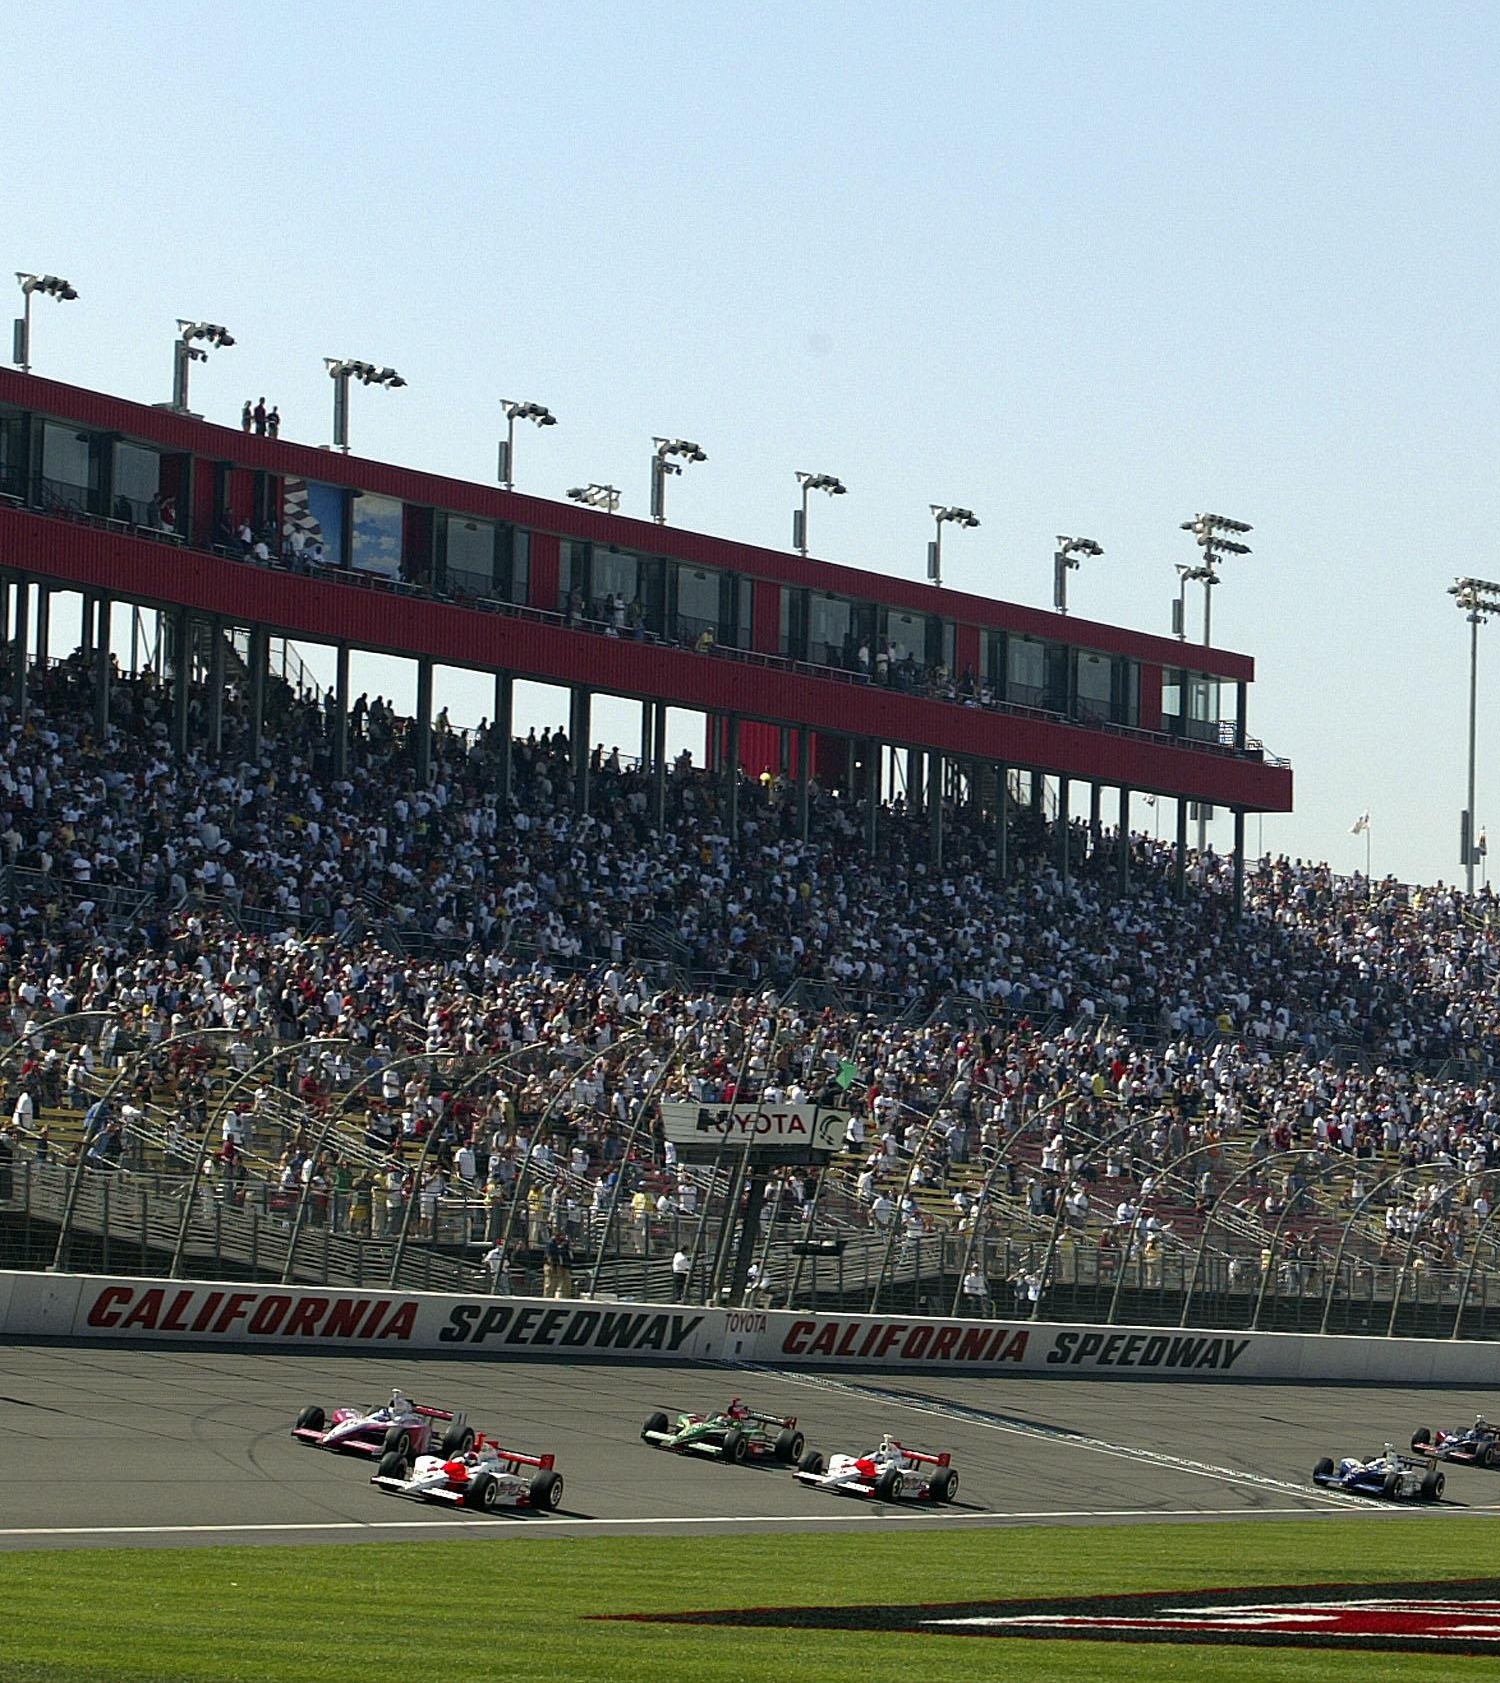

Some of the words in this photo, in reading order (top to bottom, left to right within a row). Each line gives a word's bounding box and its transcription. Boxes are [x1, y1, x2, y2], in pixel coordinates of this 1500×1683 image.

[699, 1112, 807, 1134] OYOTA
[87, 1286, 419, 1340] CALIFORNIA
[439, 1305, 705, 1350] SPEEDWAY
[724, 1313, 767, 1333] TOYOTA
[781, 1320, 1029, 1362] CALIFORNIA
[1046, 1331, 1250, 1369] SPEEDWAY
